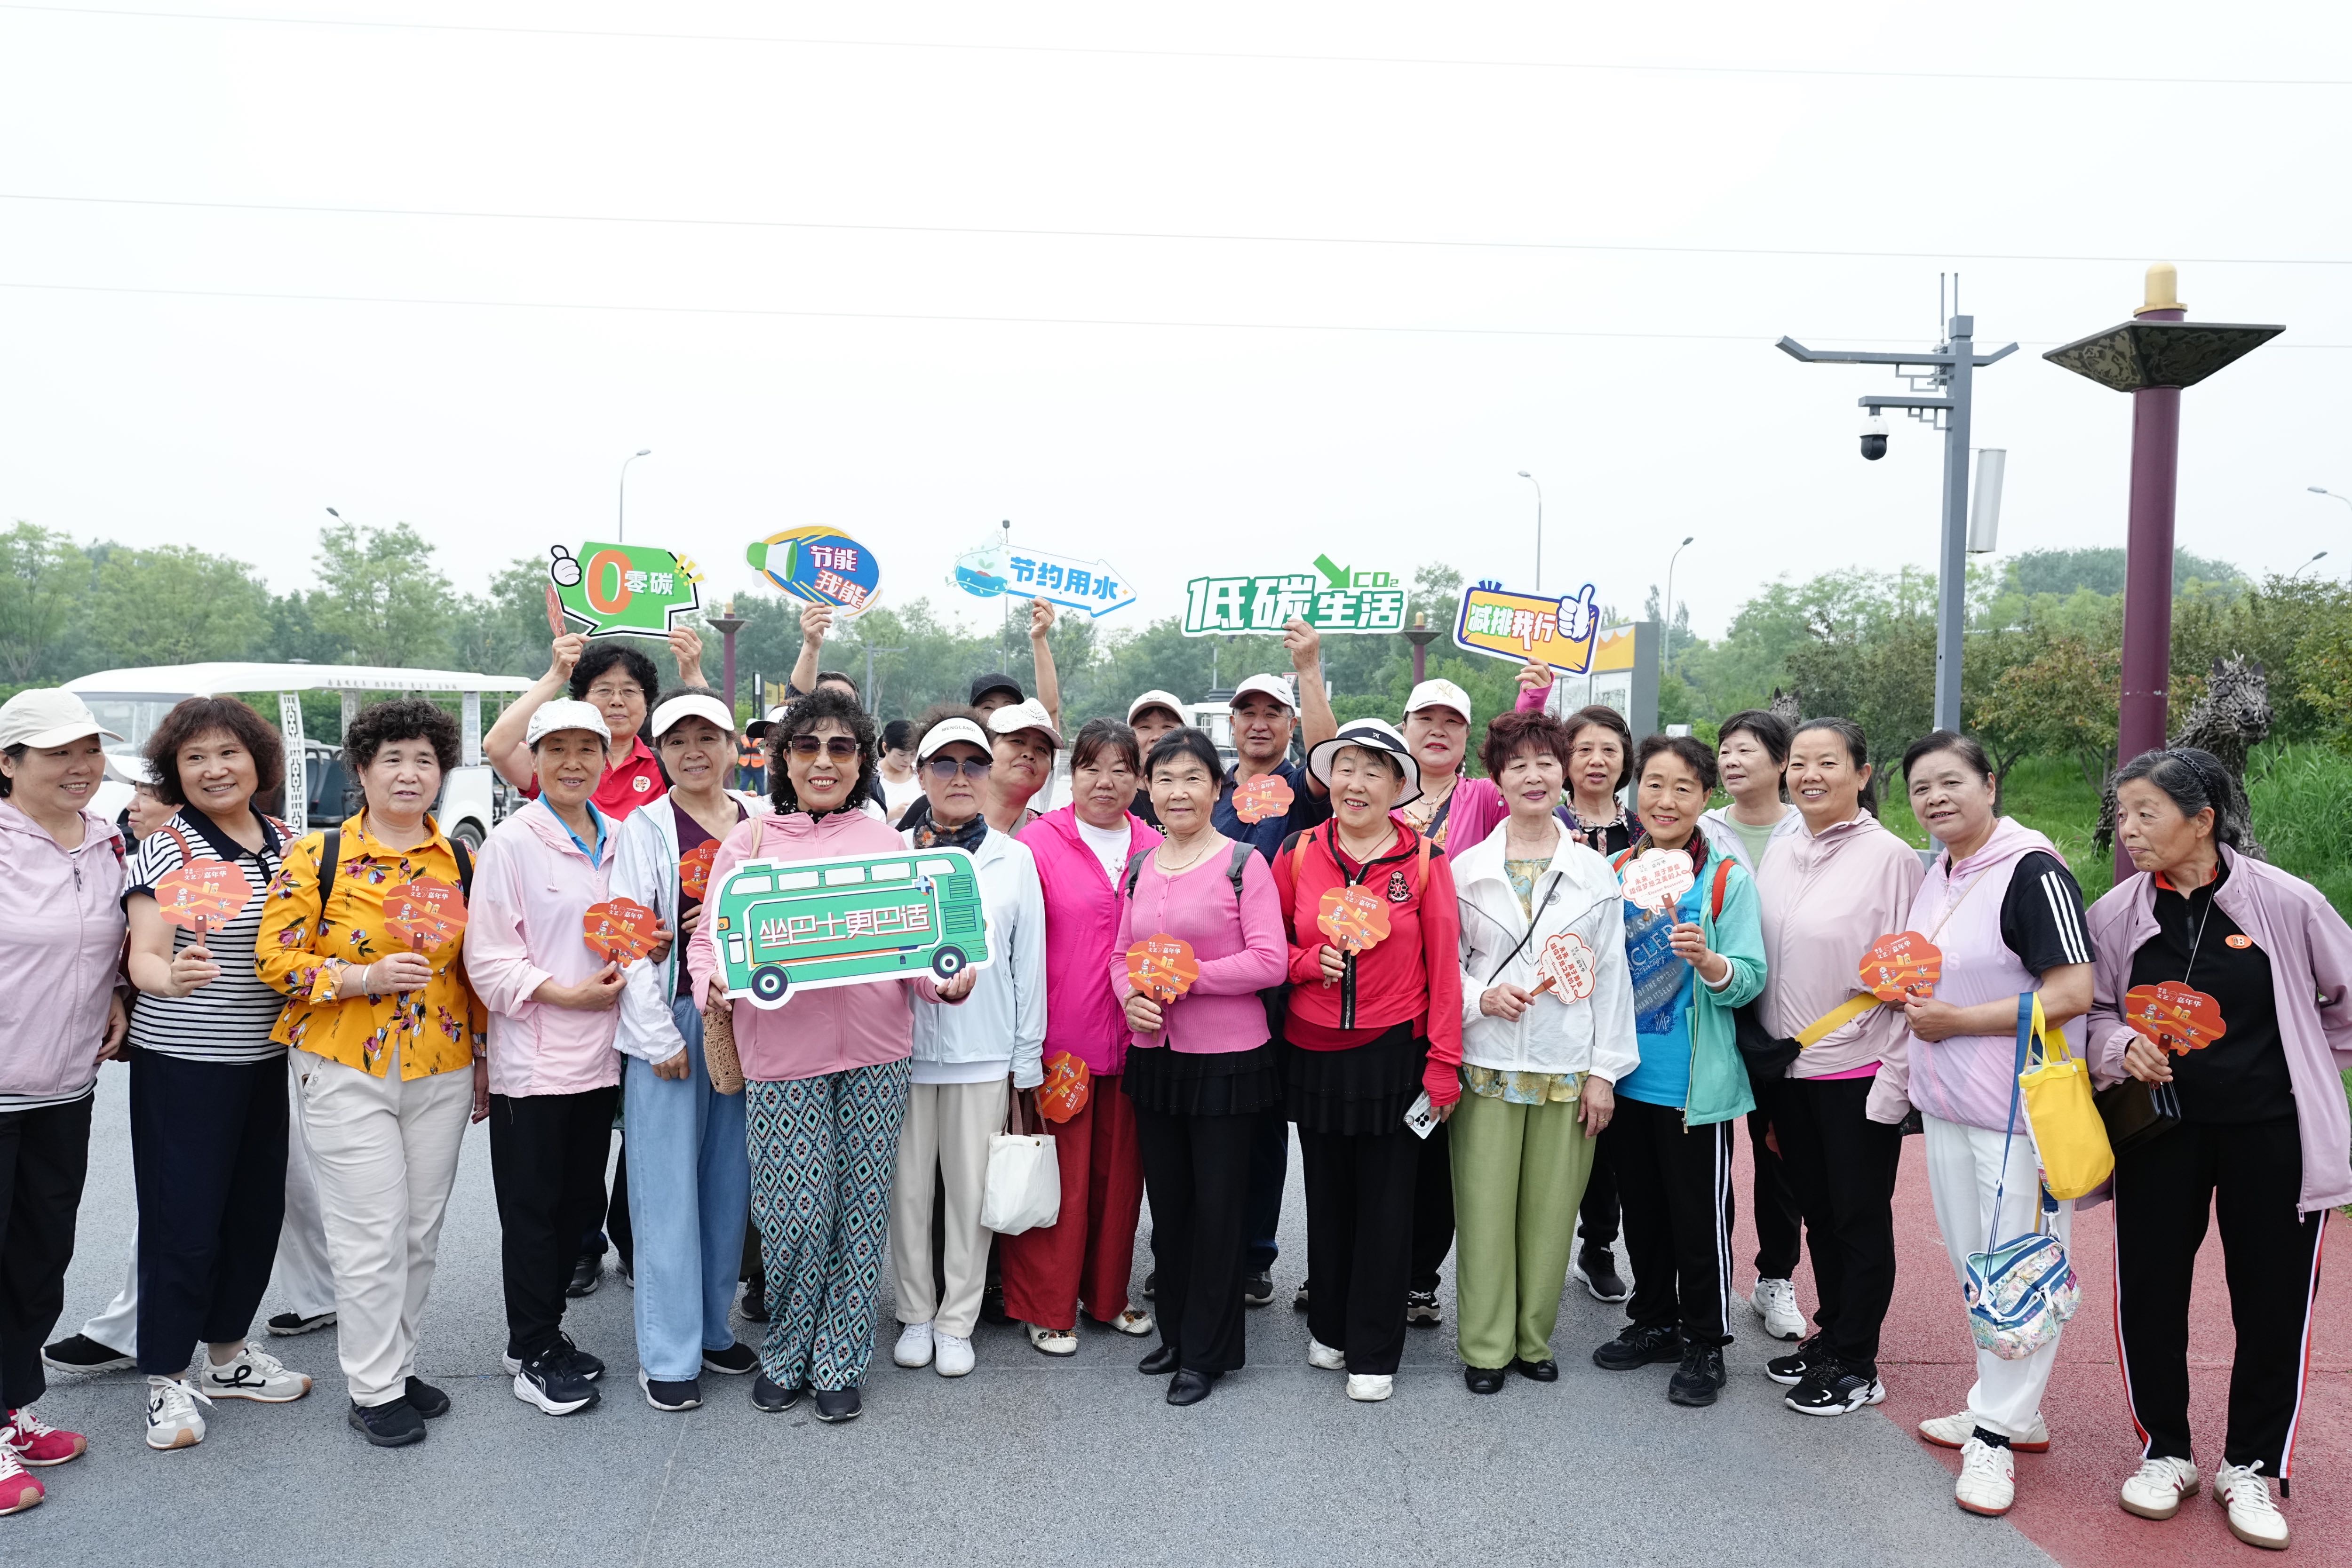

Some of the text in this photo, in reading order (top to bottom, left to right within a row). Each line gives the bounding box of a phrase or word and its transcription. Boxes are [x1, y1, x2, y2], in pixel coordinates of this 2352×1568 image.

[810, 544, 858, 572] 节能
[585, 549, 674, 615] 0 零碳
[813, 569, 868, 610] 我能
[1010, 556, 1119, 600] 节约用水
[1186, 574, 1404, 630] 低碳生活
[1466, 603, 1557, 652] 减排我行
[204, 870, 227, 879] 嘉年华
[624, 911, 643, 920] 嘉年华
[1358, 899, 1377, 910] 嘉年华
[759, 903, 931, 948] 坐巴士更巴适
[1892, 940, 1911, 953] 嘉年华
[1638, 987, 1645, 996] OF
[1645, 980, 1657, 991] THE
[1656, 968, 1677, 984] SPIRIT
[1635, 983, 1673, 1012] BRAND ITSELF
[2177, 996, 2201, 1007] 嘉年华
